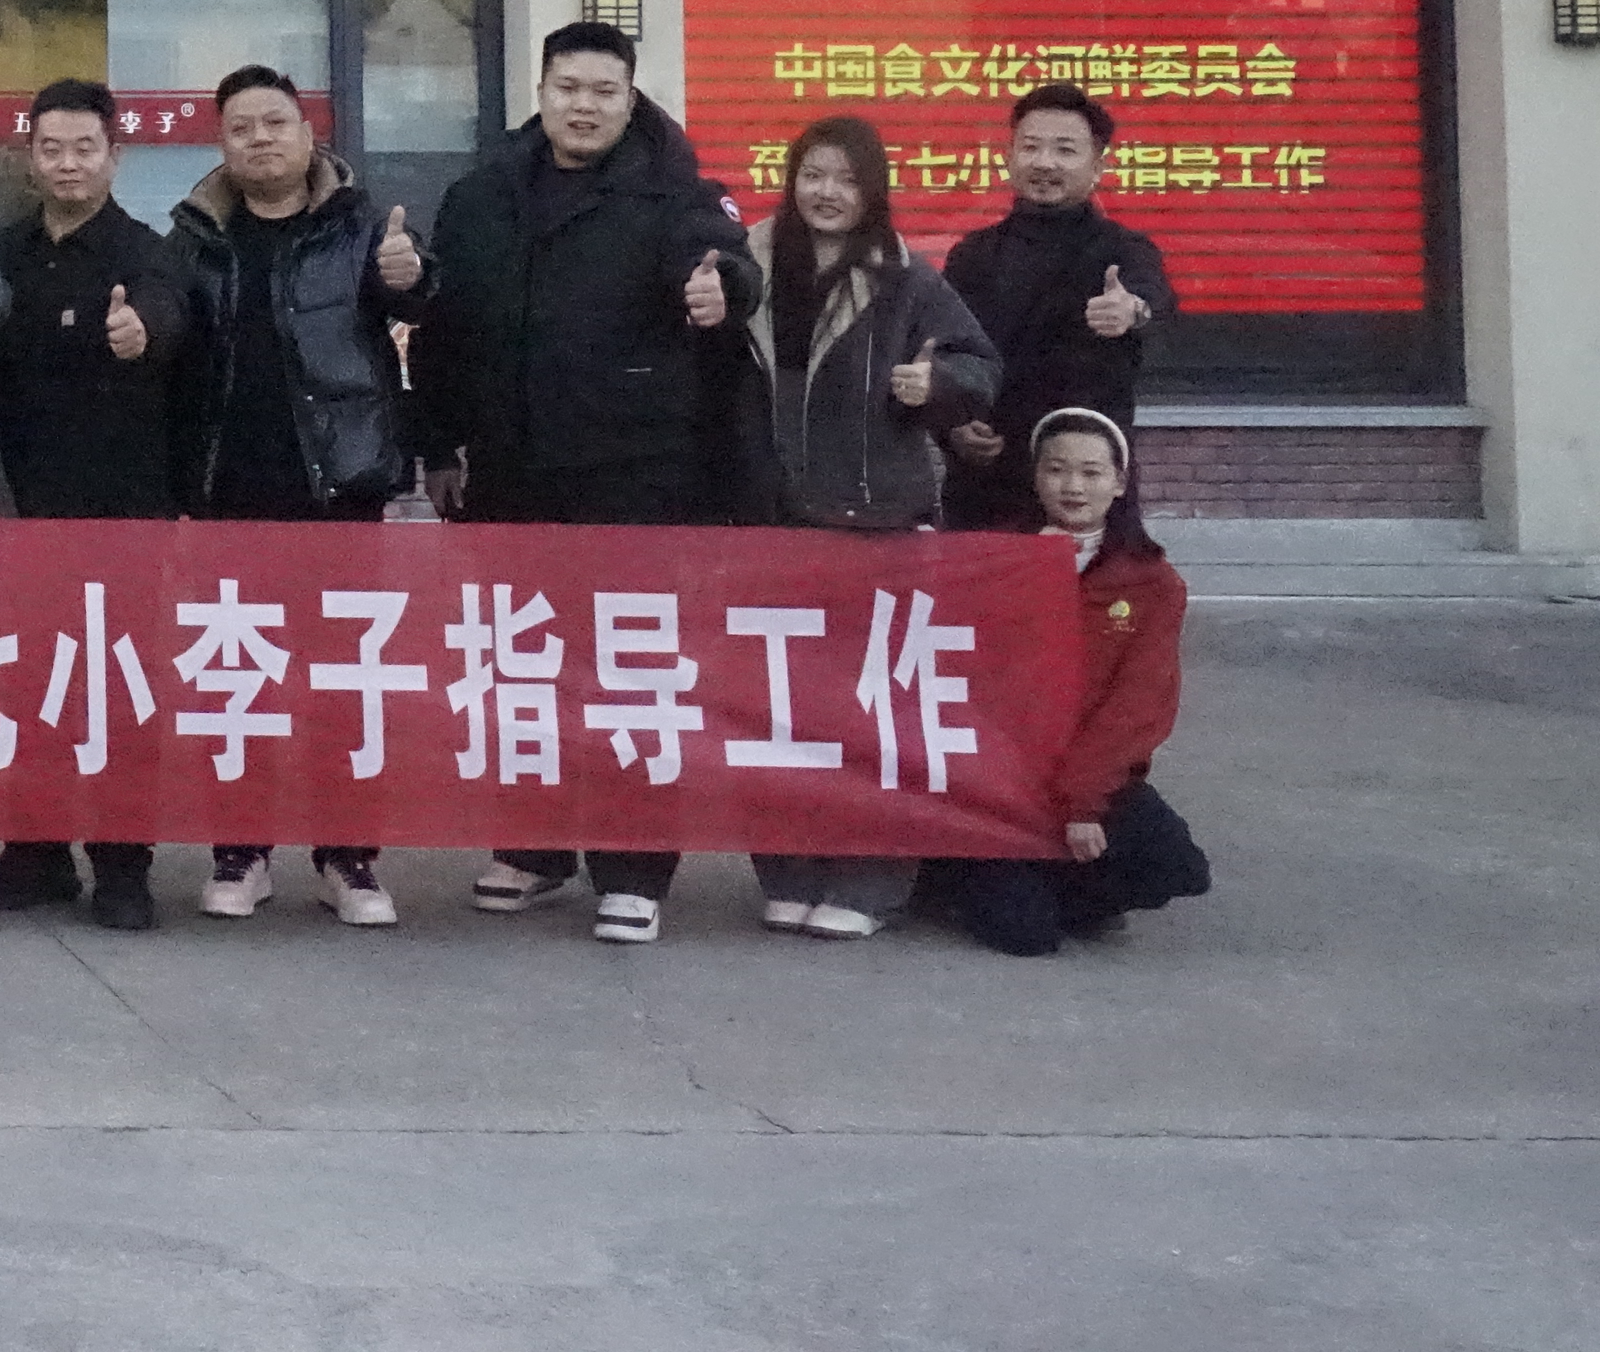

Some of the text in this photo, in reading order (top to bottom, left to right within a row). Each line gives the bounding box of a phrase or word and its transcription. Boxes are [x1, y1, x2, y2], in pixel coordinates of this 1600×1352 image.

[774, 43, 1297, 98] 中国食文化河鲜委员会
